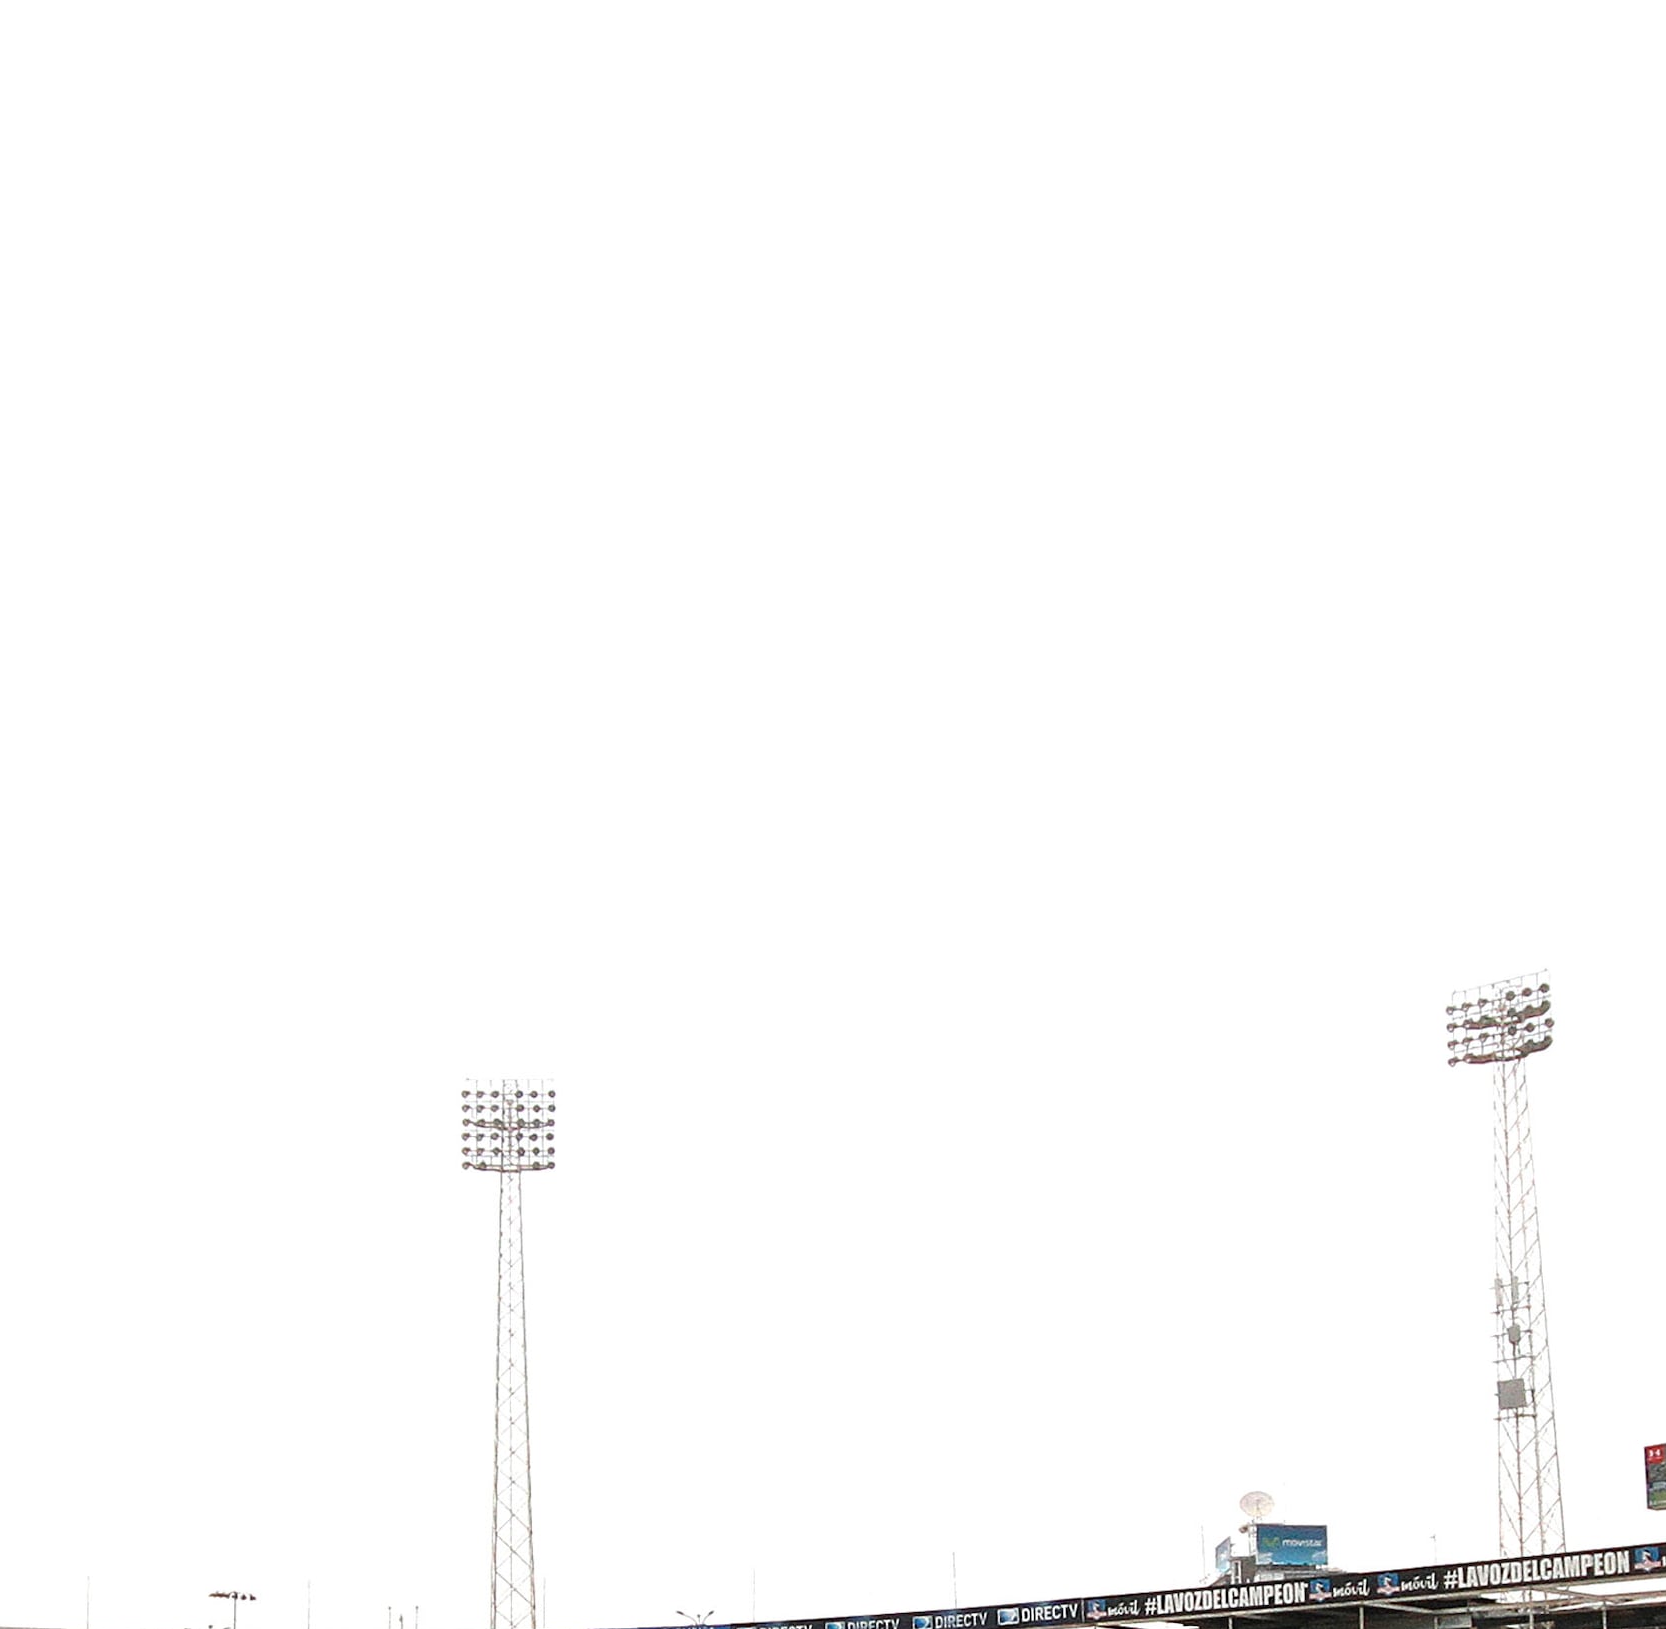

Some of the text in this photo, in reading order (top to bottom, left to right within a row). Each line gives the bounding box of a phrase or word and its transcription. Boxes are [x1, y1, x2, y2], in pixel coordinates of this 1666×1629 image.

[1443, 1550, 1630, 1589] #LAVOZDELCAMPEON
[1144, 1582, 1307, 1615] #LAVOZDELCAMPEON
[934, 1613, 988, 1629] DIRECTV
[1021, 1604, 1079, 1623] DIRECTV
